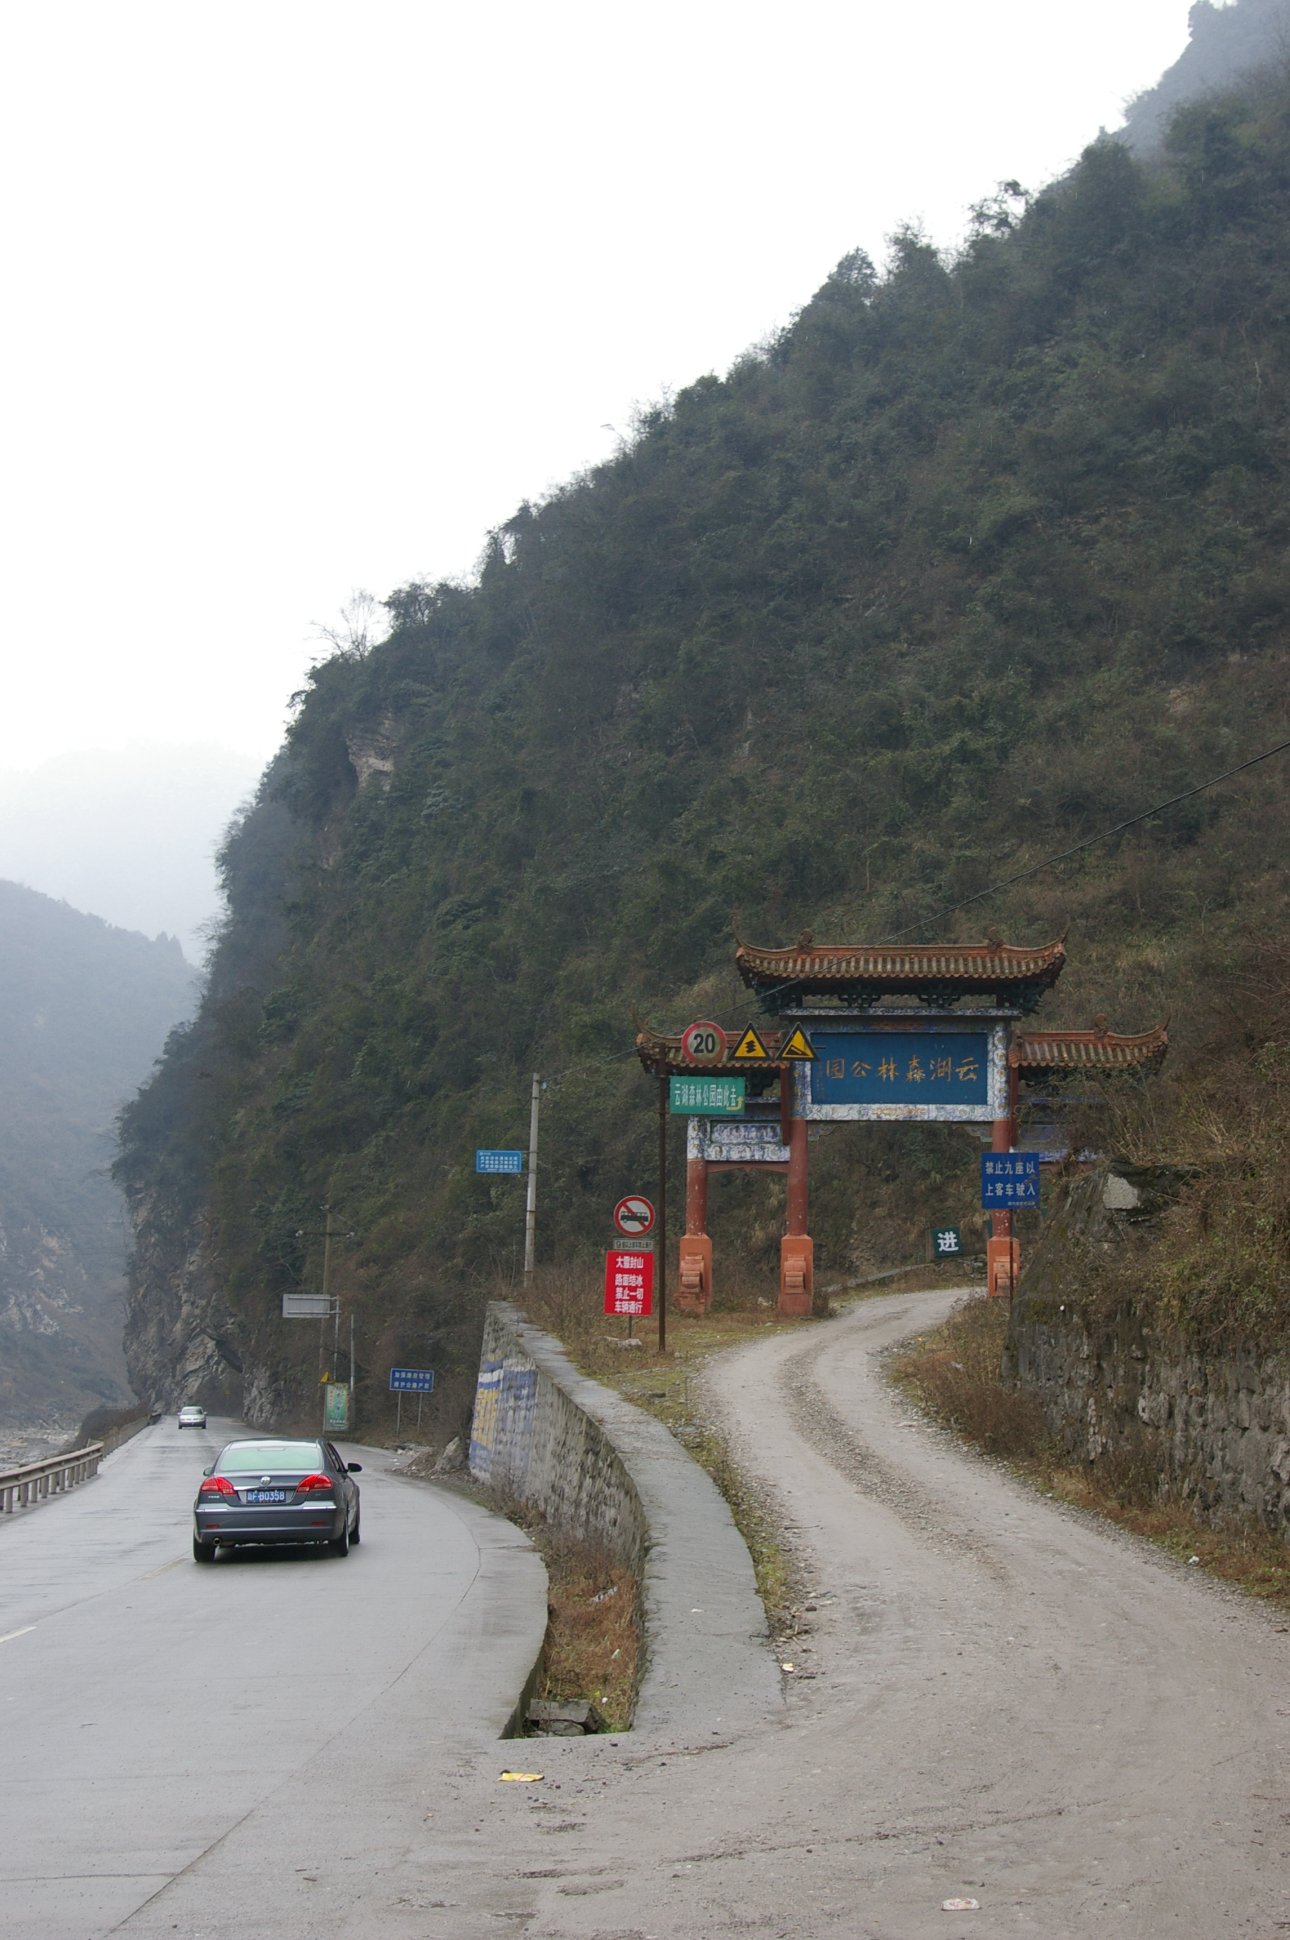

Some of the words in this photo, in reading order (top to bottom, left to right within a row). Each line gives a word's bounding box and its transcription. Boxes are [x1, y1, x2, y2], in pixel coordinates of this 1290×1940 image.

[693, 1033, 716, 1054] 20
[674, 1083, 737, 1107] 云湖森林公园由此去
[985, 1161, 1036, 1175] 禁止九座以
[985, 1183, 1036, 1196] 上客车驶入
[937, 1231, 959, 1252] 进
[615, 1255, 644, 1269] 大雪封山
[614, 1273, 644, 1287] 路面结冰
[615, 1286, 644, 1300] 禁止一切
[614, 1300, 643, 1314] 车辆通行
